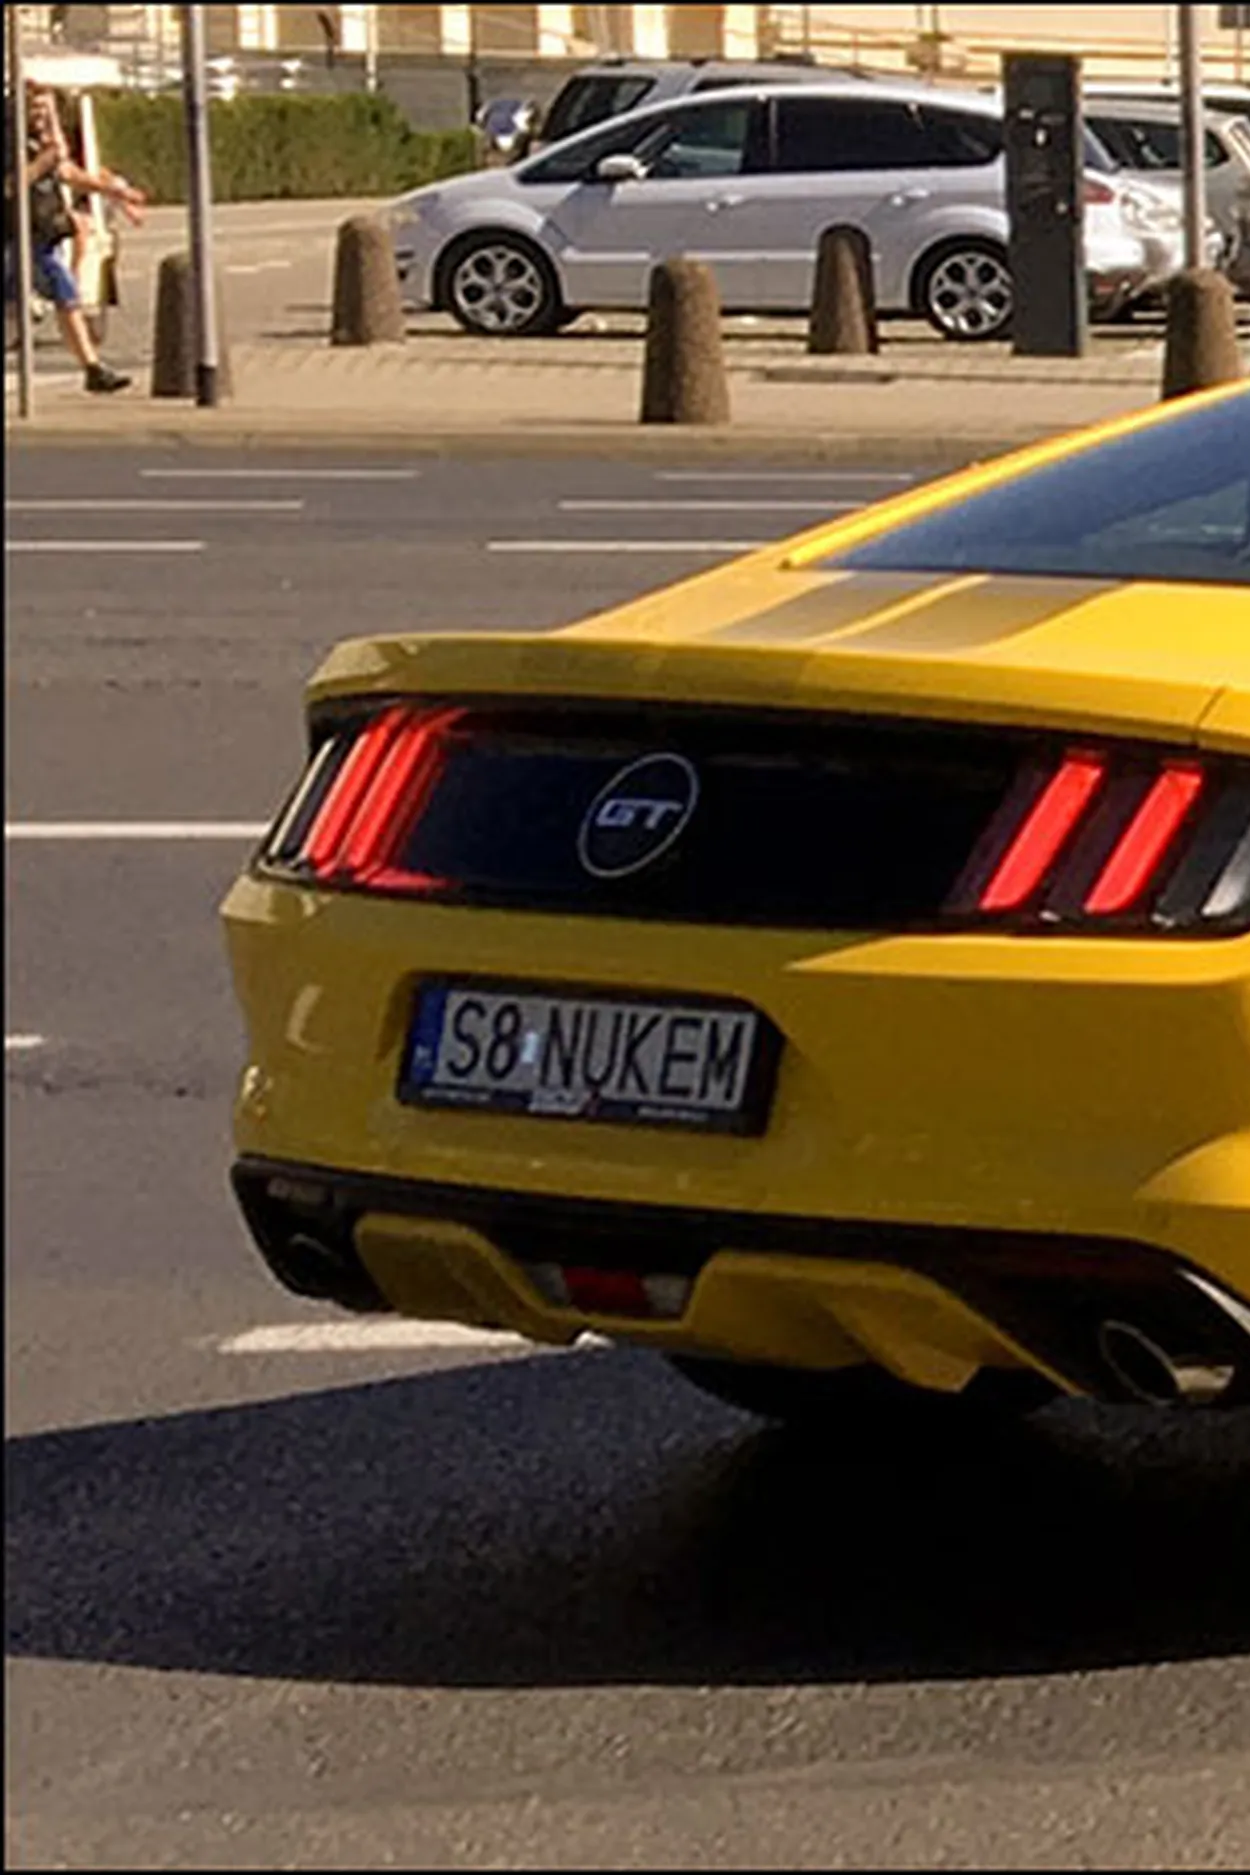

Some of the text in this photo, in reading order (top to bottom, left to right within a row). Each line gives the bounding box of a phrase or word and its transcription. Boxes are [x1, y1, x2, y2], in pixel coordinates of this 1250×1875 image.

[595, 798, 684, 829] GT
[446, 1000, 746, 1102] S8 NUKEM
